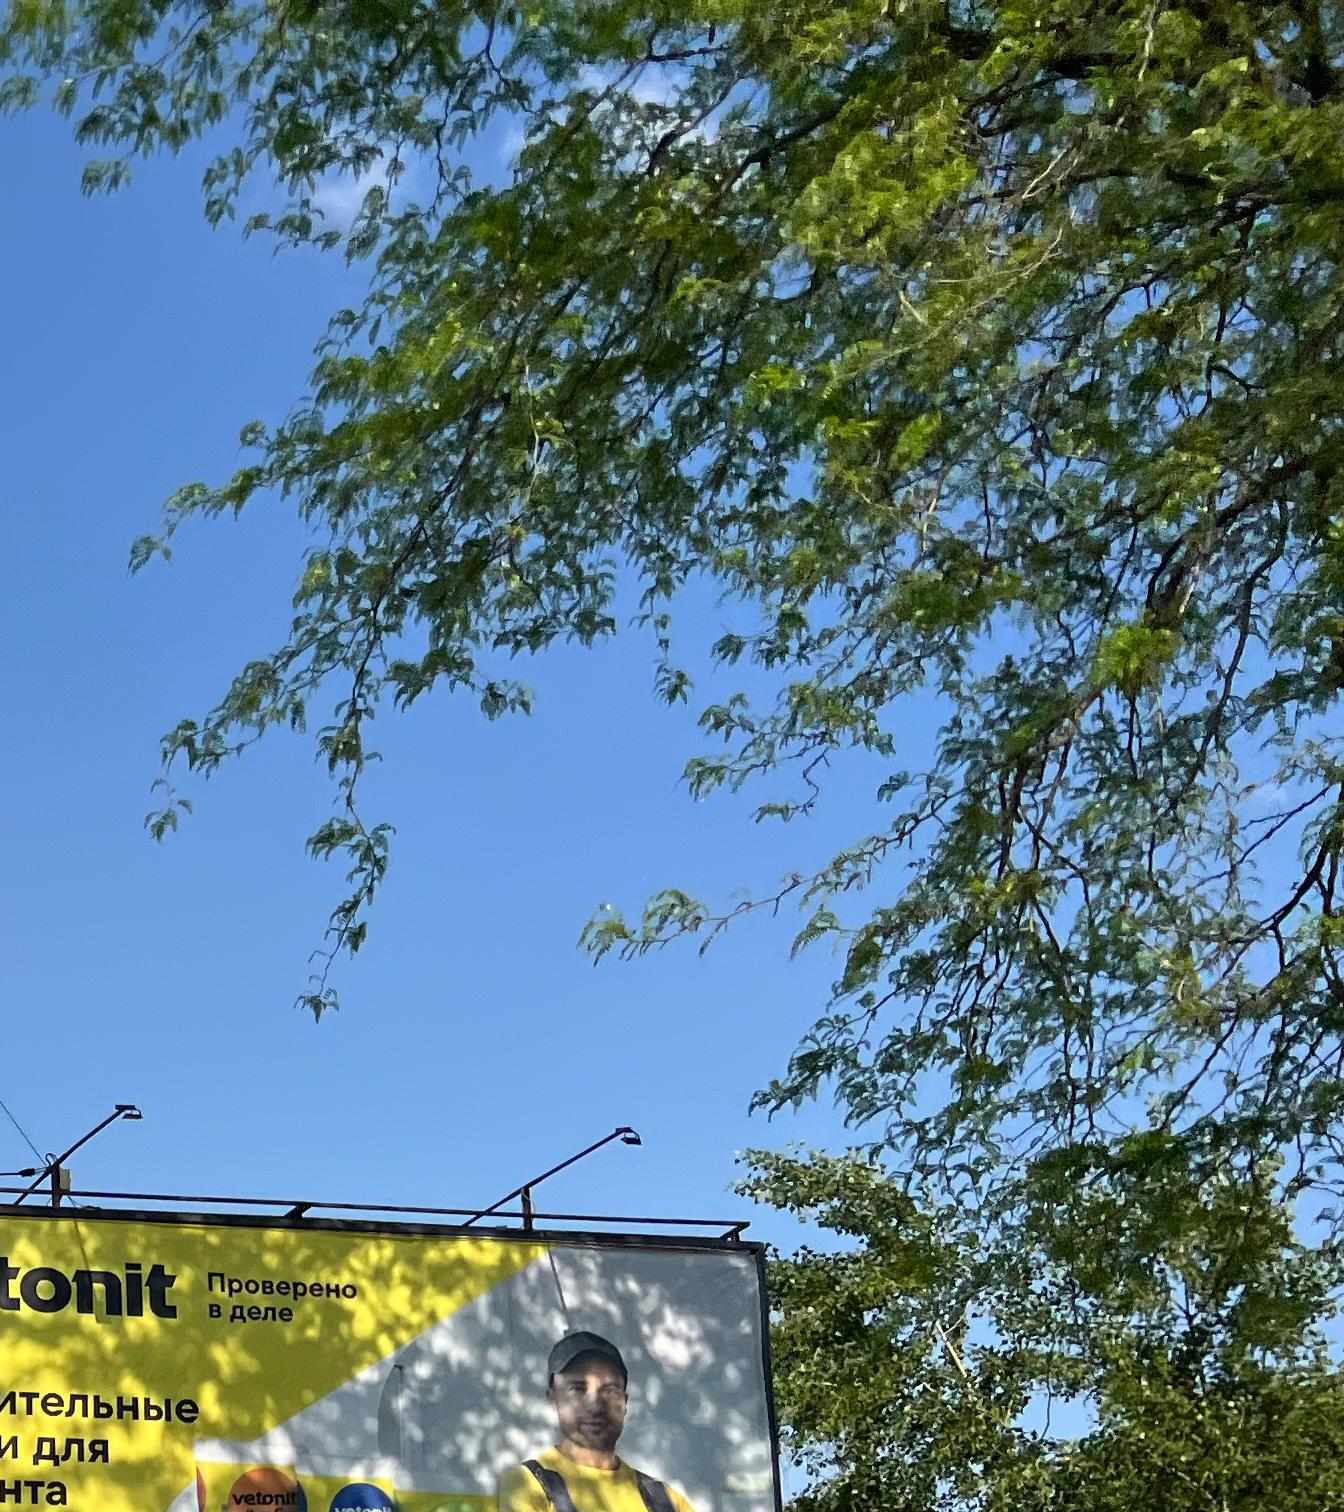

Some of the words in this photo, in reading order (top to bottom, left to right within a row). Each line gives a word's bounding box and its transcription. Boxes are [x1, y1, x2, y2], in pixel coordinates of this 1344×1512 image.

[207, 1271, 358, 1301] Проверено
[208, 1303, 223, 1320] в
[229, 1304, 294, 1323] деле
[32, 1438, 110, 1467] для
[232, 1491, 297, 1506] vetonit
